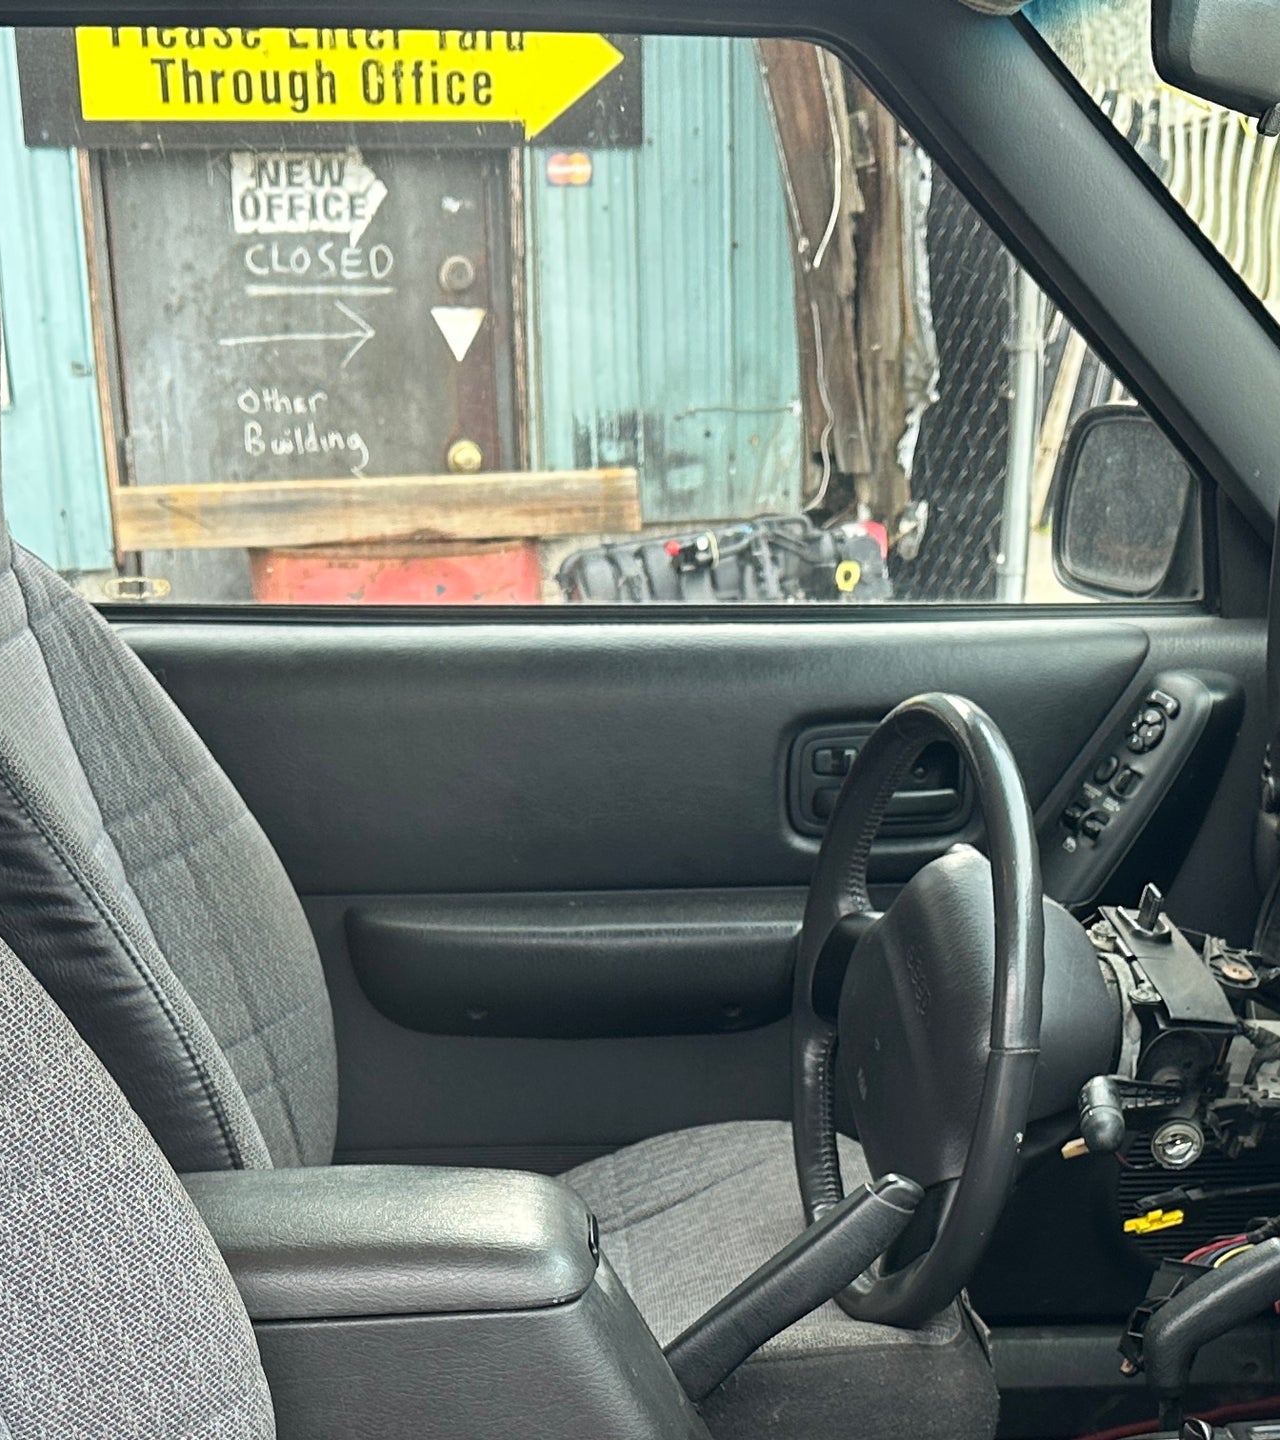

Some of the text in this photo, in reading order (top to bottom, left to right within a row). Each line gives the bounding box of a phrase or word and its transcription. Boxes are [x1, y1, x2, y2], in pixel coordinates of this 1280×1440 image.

[150, 57, 493, 113] Through Office
[257, 159, 345, 188] NEW
[239, 189, 368, 223] OFFICE
[244, 241, 394, 280] CLOSED
[236, 386, 328, 415] Other
[243, 419, 370, 479] Building
